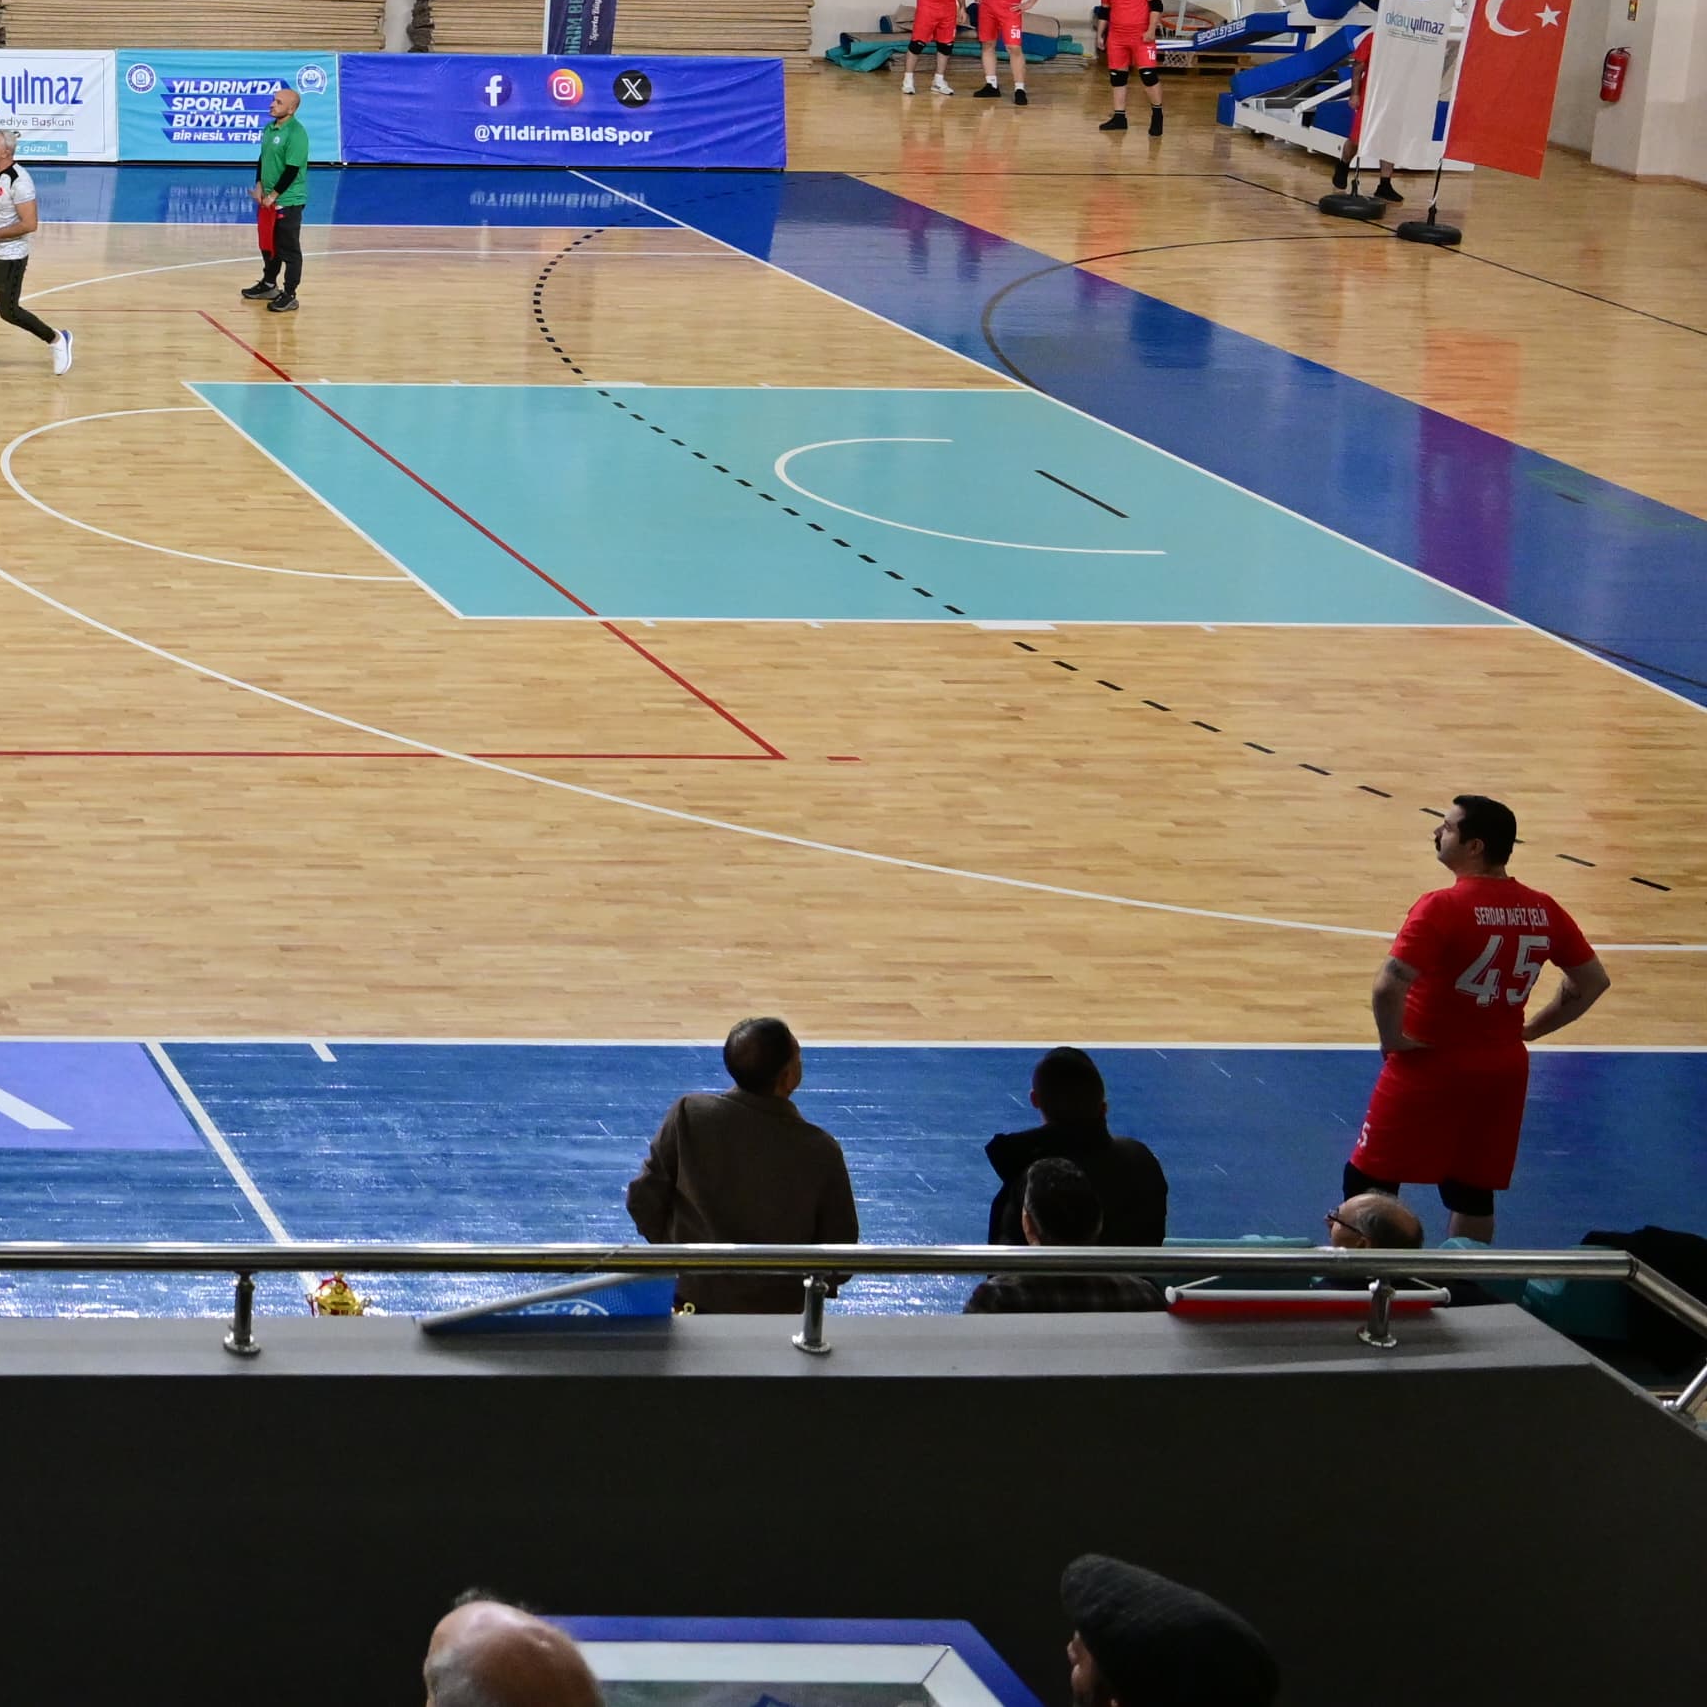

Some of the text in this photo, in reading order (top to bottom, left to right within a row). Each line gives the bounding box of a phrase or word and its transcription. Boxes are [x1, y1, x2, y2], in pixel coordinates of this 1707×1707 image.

[171, 79, 283, 95] YILDIRIM'DA
[170, 96, 246, 111] SPORLA
[31, 117, 75, 128] Başkanı
[171, 110, 260, 129] BÜYÜYEN
[172, 129, 263, 144] BİR NESİL YETİŞİ
[473, 124, 653, 145] @YildirimBldSpor
[1474, 906, 1506, 927] SERDAR
[1454, 934, 1551, 1008] 45
